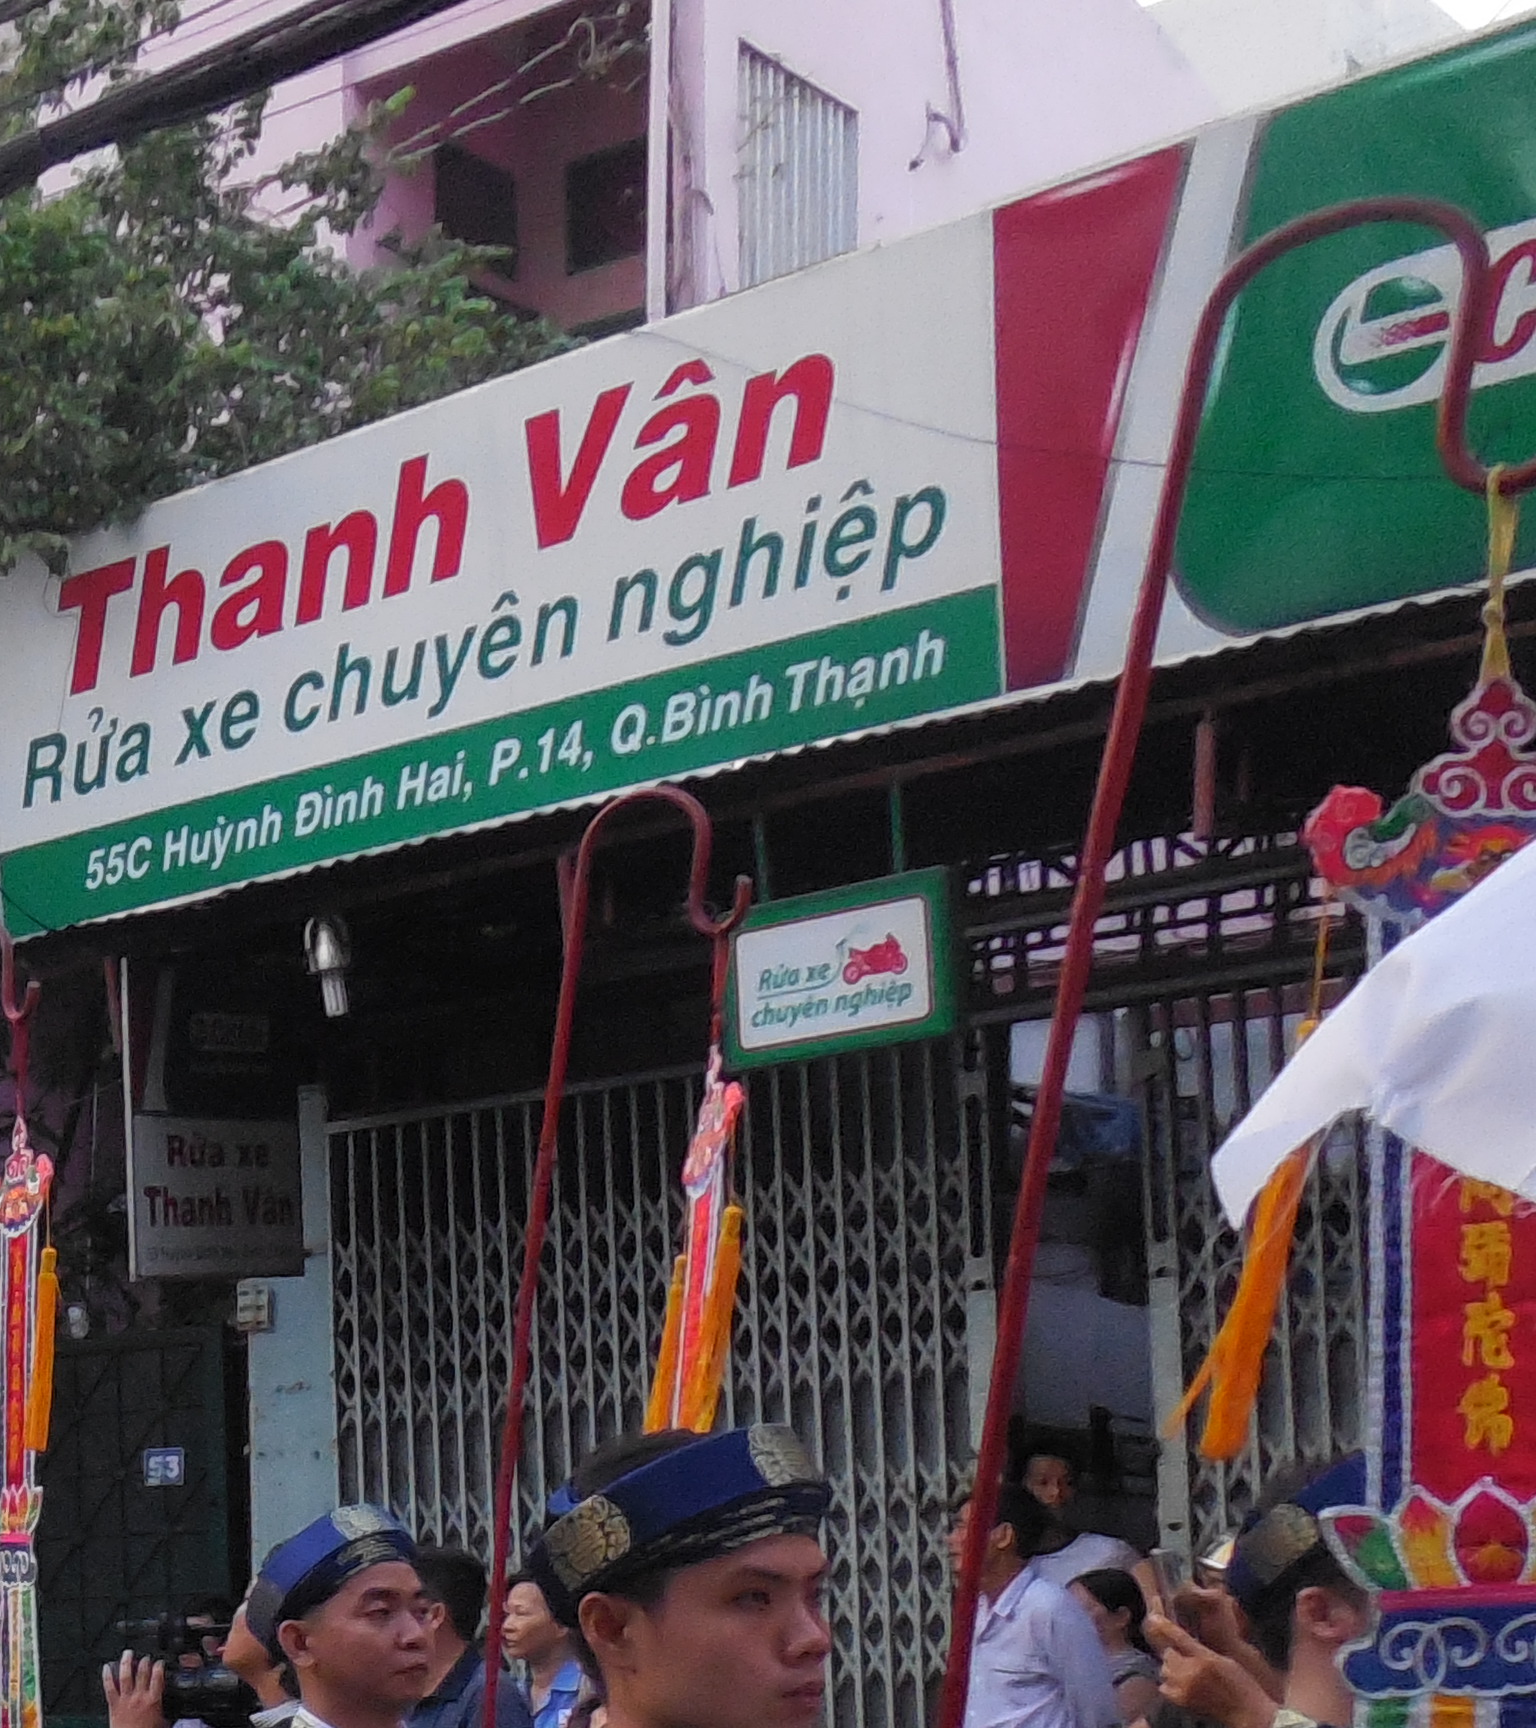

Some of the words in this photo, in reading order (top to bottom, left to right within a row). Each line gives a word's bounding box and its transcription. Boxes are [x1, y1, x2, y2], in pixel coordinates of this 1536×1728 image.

[57, 453, 469, 697] Thanh
[525, 353, 834, 550] Vân
[22, 706, 151, 809] Rửa
[175, 689, 260, 766] xe
[283, 590, 579, 733] chuyên
[607, 478, 948, 647] nghiệp
[85, 834, 153, 891] 55C
[162, 804, 282, 871] Huỳnh
[294, 776, 385, 838] Đình
[395, 750, 474, 812] Hai,
[489, 720, 593, 792] P.14,
[611, 674, 774, 755] Q.Bình
[785, 629, 946, 713] Thạnh
[757, 963, 800, 993] Rửa
[805, 961, 832, 983] xe
[750, 996, 829, 1028] chuyên
[833, 979, 913, 1018] nghiệp
[142, 1184, 234, 1228] Thanh
[147, 1454, 180, 1479] 53
